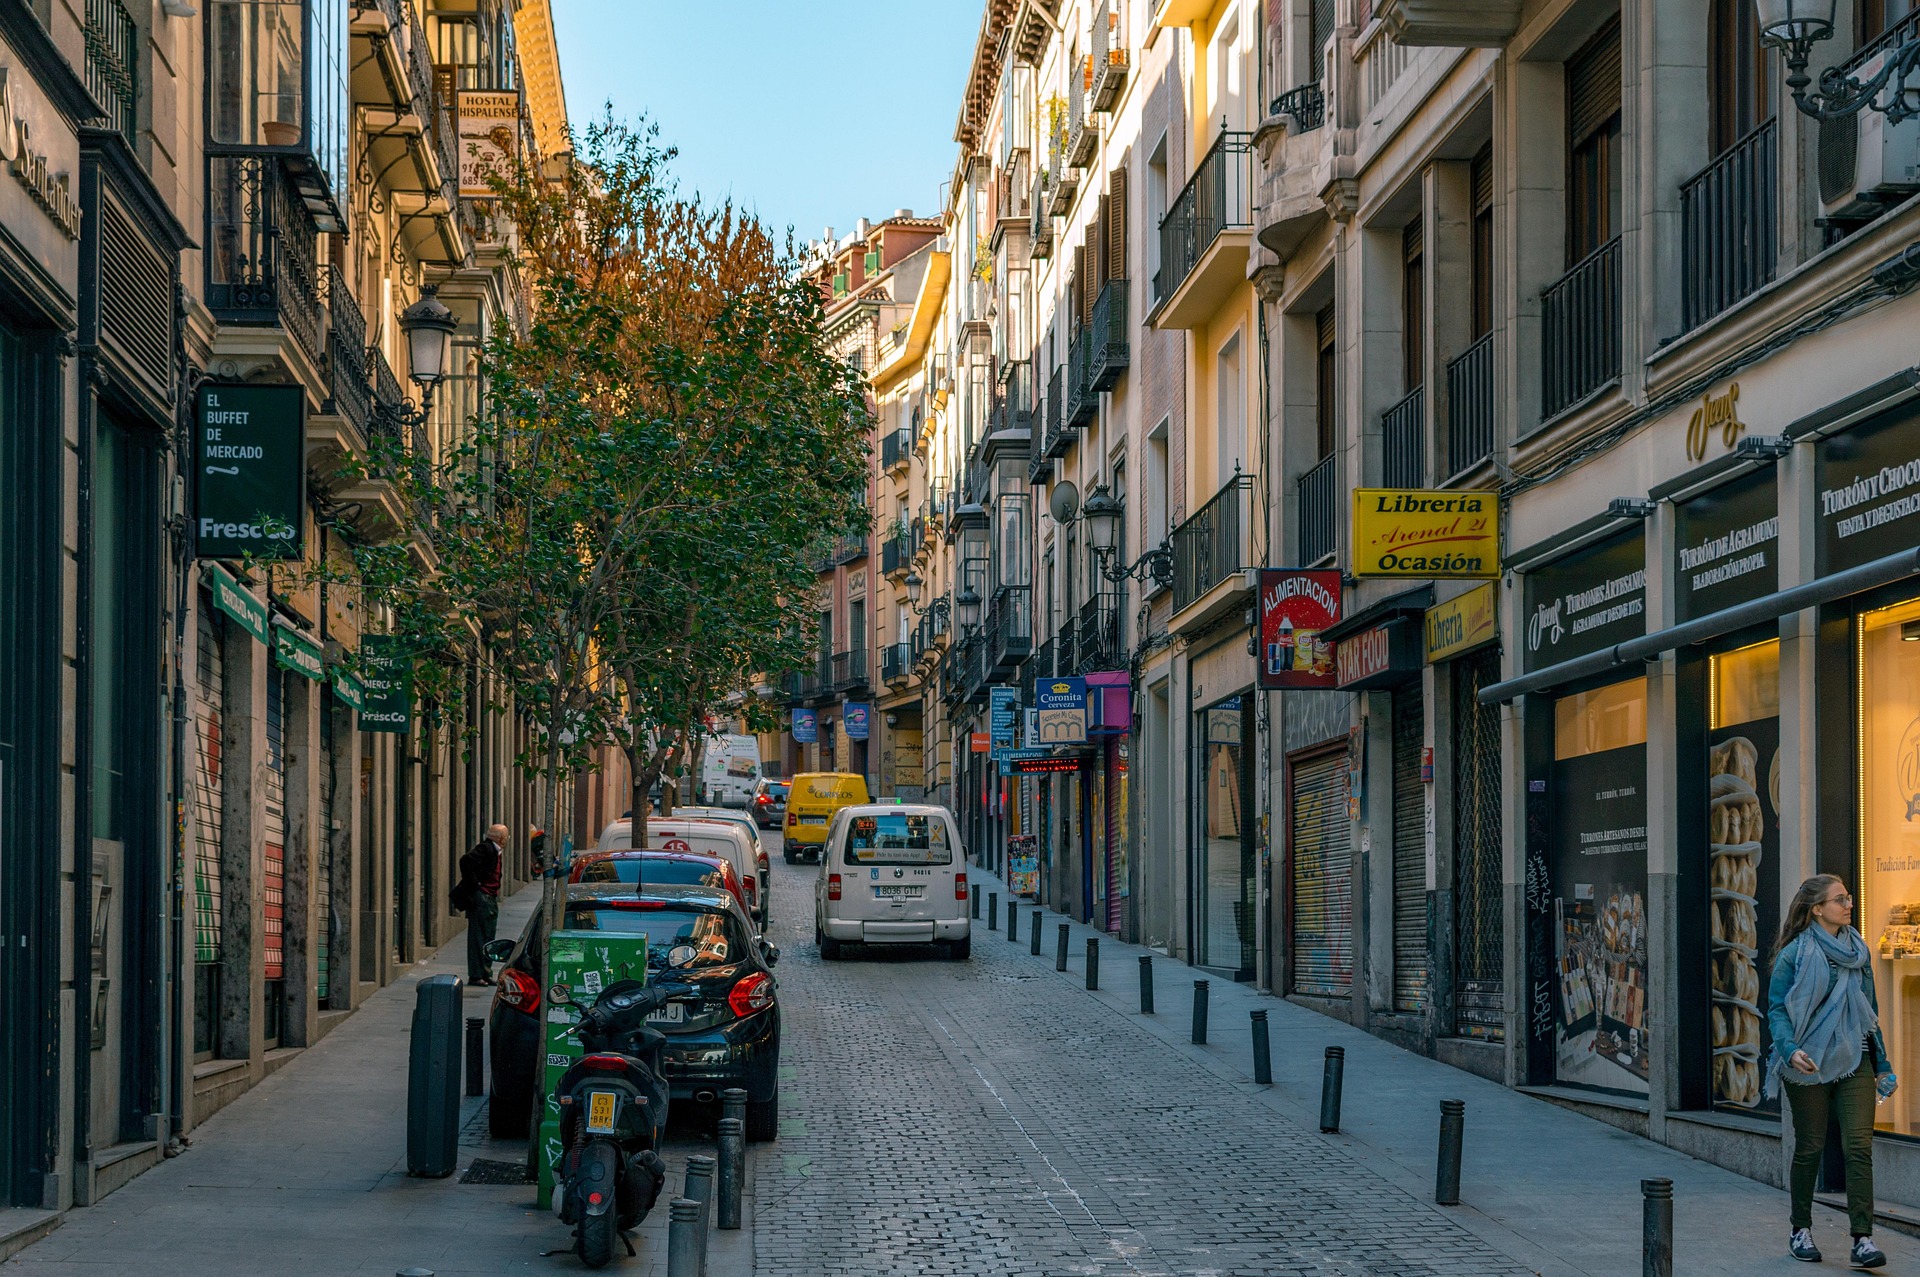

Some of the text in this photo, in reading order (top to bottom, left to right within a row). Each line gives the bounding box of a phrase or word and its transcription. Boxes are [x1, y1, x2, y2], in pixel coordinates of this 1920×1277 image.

[466, 96, 512, 106] HOSTAL
[459, 107, 517, 117] HISPALENSE
[20, 119, 84, 241] Santander
[462, 176, 478, 185] 685
[207, 394, 220, 407] EL
[207, 411, 249, 425] BUFFET
[1686, 381, 1745, 462] Vicens
[207, 428, 222, 441] DE
[206, 445, 263, 459] MERCADO
[1376, 494, 1482, 513] Librería
[1821, 475, 1870, 517] TURRÓN
[1372, 517, 1488, 545] Arenal 21
[1836, 514, 1866, 539] VENTA
[1378, 553, 1482, 571] Ocasión
[1680, 537, 1715, 572] TURRÓN
[1715, 535, 1729, 559] DE
[1692, 551, 1766, 591] ELABORACIÓN PROPIA
[1263, 576, 1337, 618] ALIMENTACION
[1565, 584, 1605, 615] TURRONES
[1428, 603, 1463, 653] Librería
[1528, 598, 1565, 652] Vicens
[1571, 610, 1609, 635] AGRAMUNT
[1607, 603, 1629, 623] DESDE
[1337, 628, 1389, 686] STAR FOOD
[1040, 693, 1082, 703] Coronita
[668, 841, 684, 850] 15
[1875, 855, 1906, 873] Tradición
[882, 887, 901, 895] 8036
[594, 1107, 610, 1115] 531
